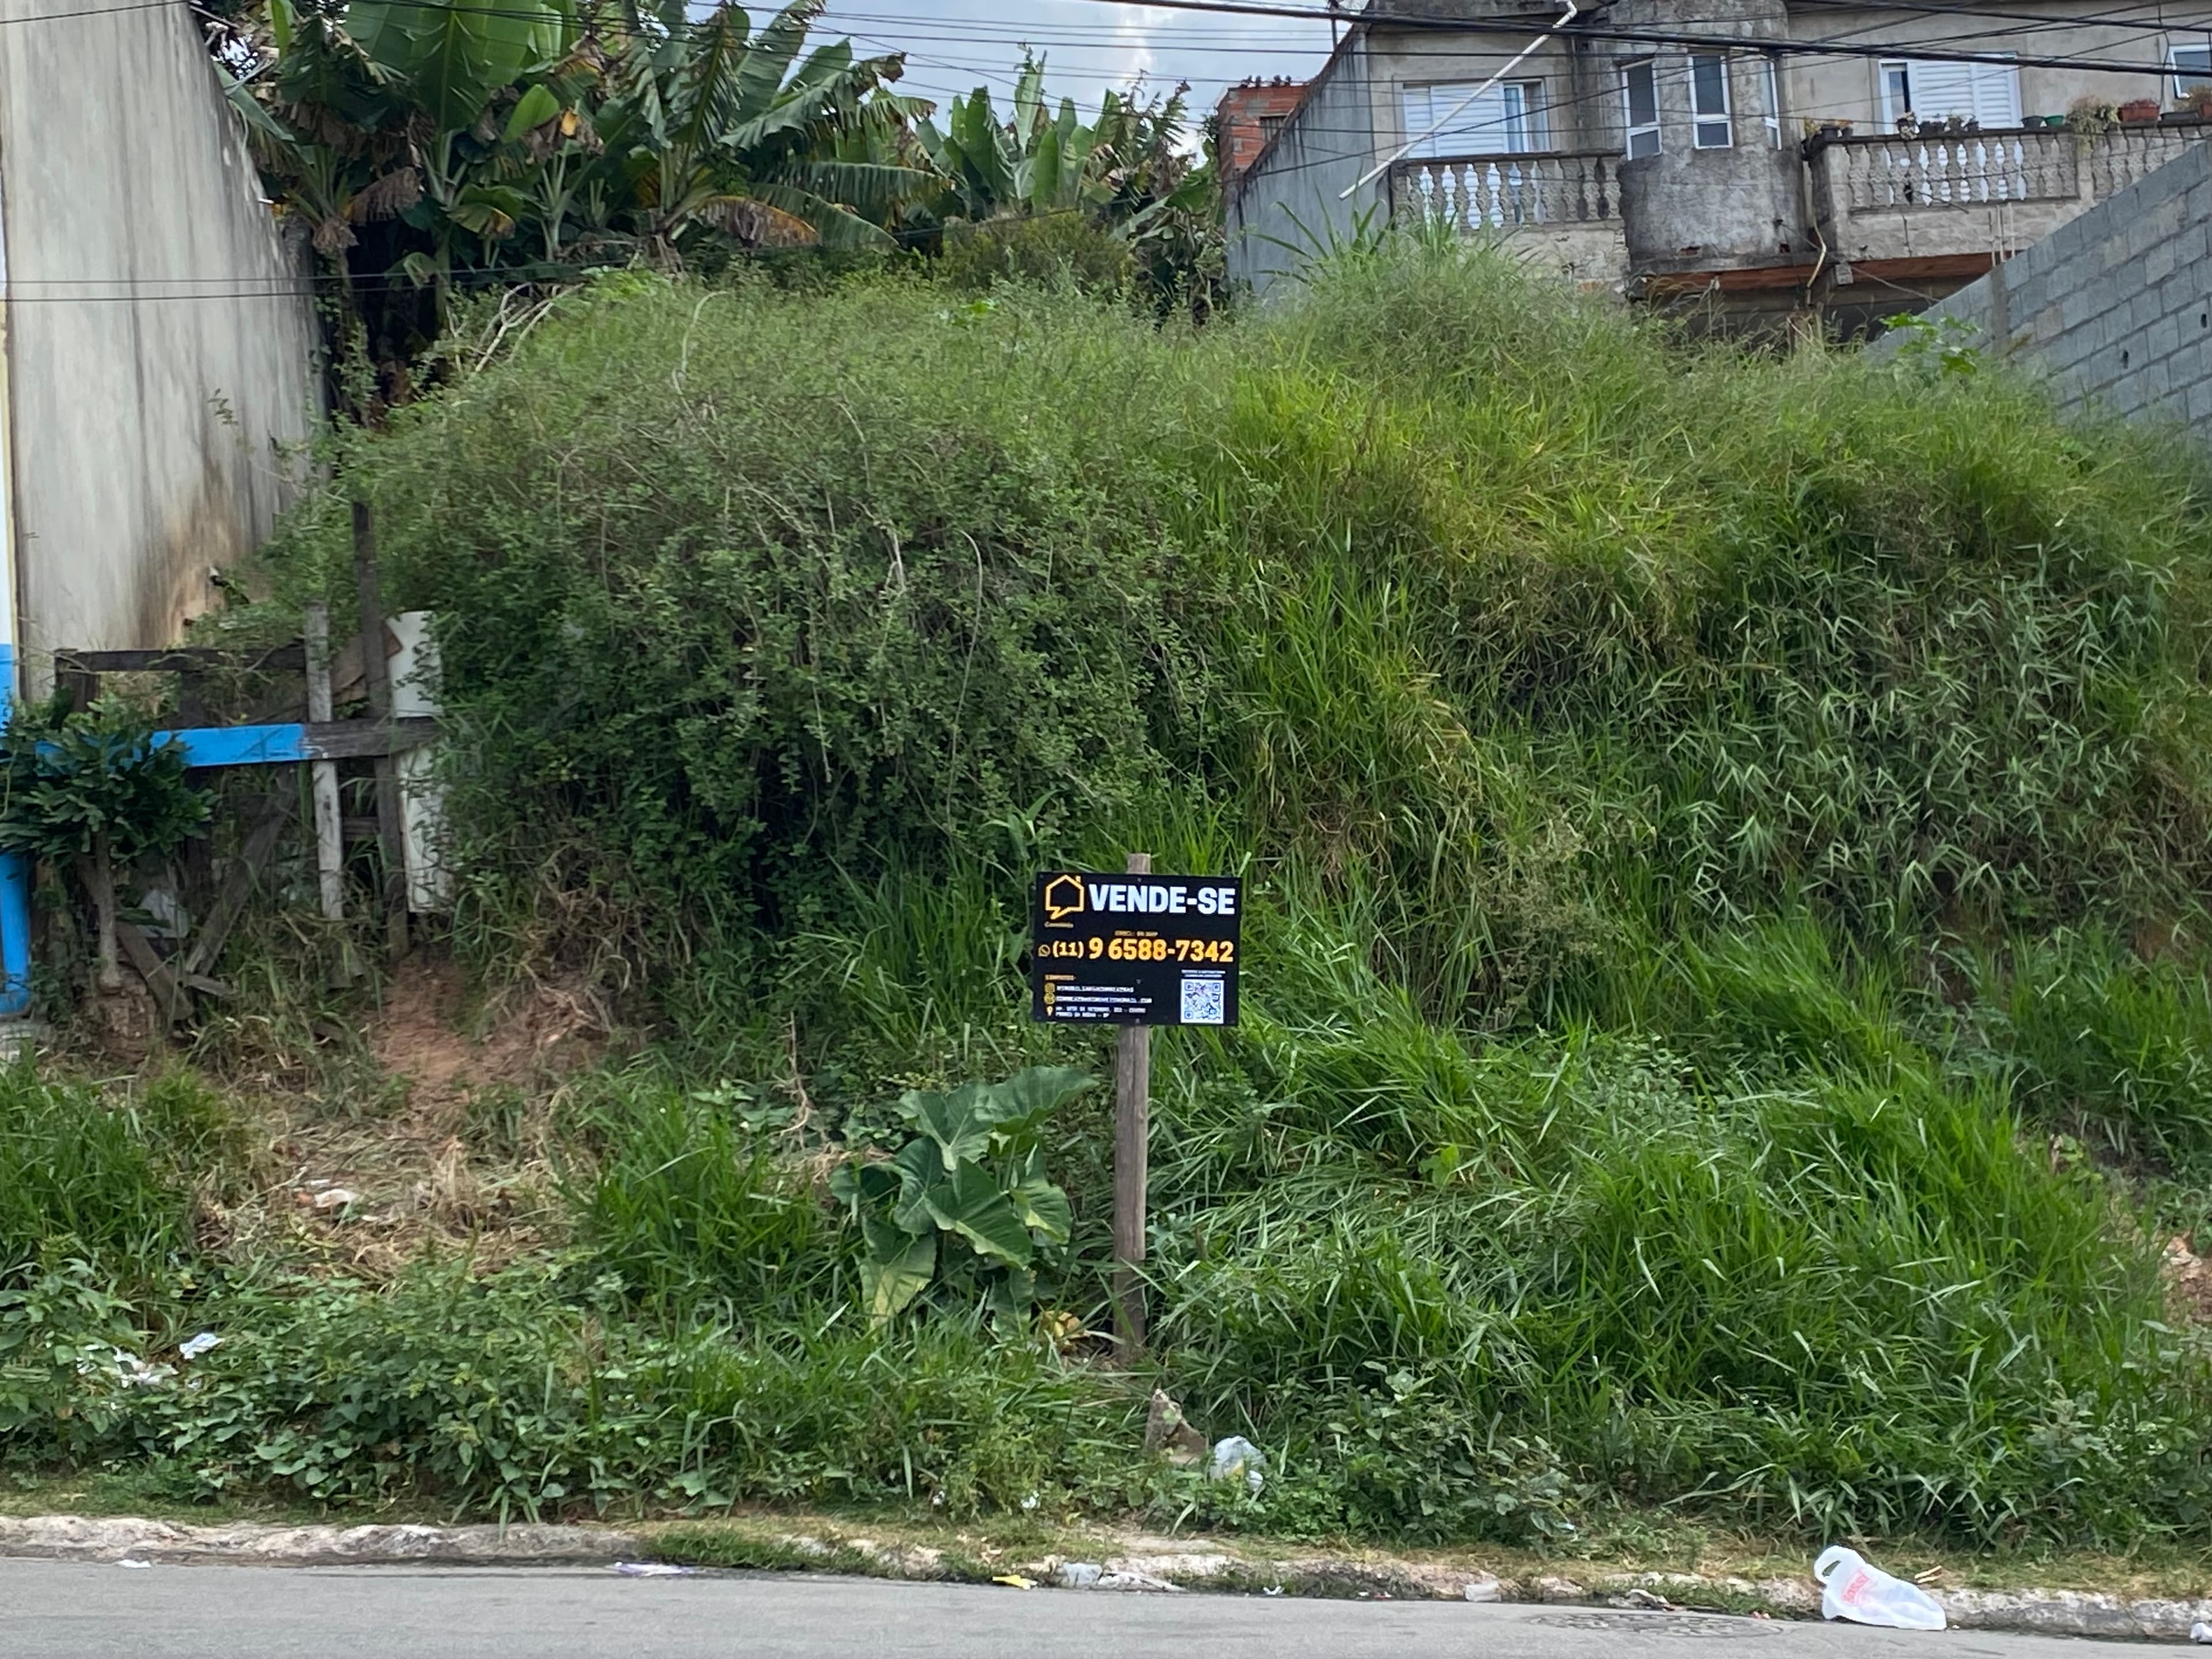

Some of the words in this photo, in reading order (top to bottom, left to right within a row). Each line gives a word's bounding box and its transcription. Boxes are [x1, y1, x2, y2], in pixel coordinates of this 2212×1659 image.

[1088, 884, 1236, 915] VENDE-SE
[1052, 940, 1084, 959] (11)
[1088, 937, 1104, 959] 9
[1108, 938, 1234, 963] 6588-7342
